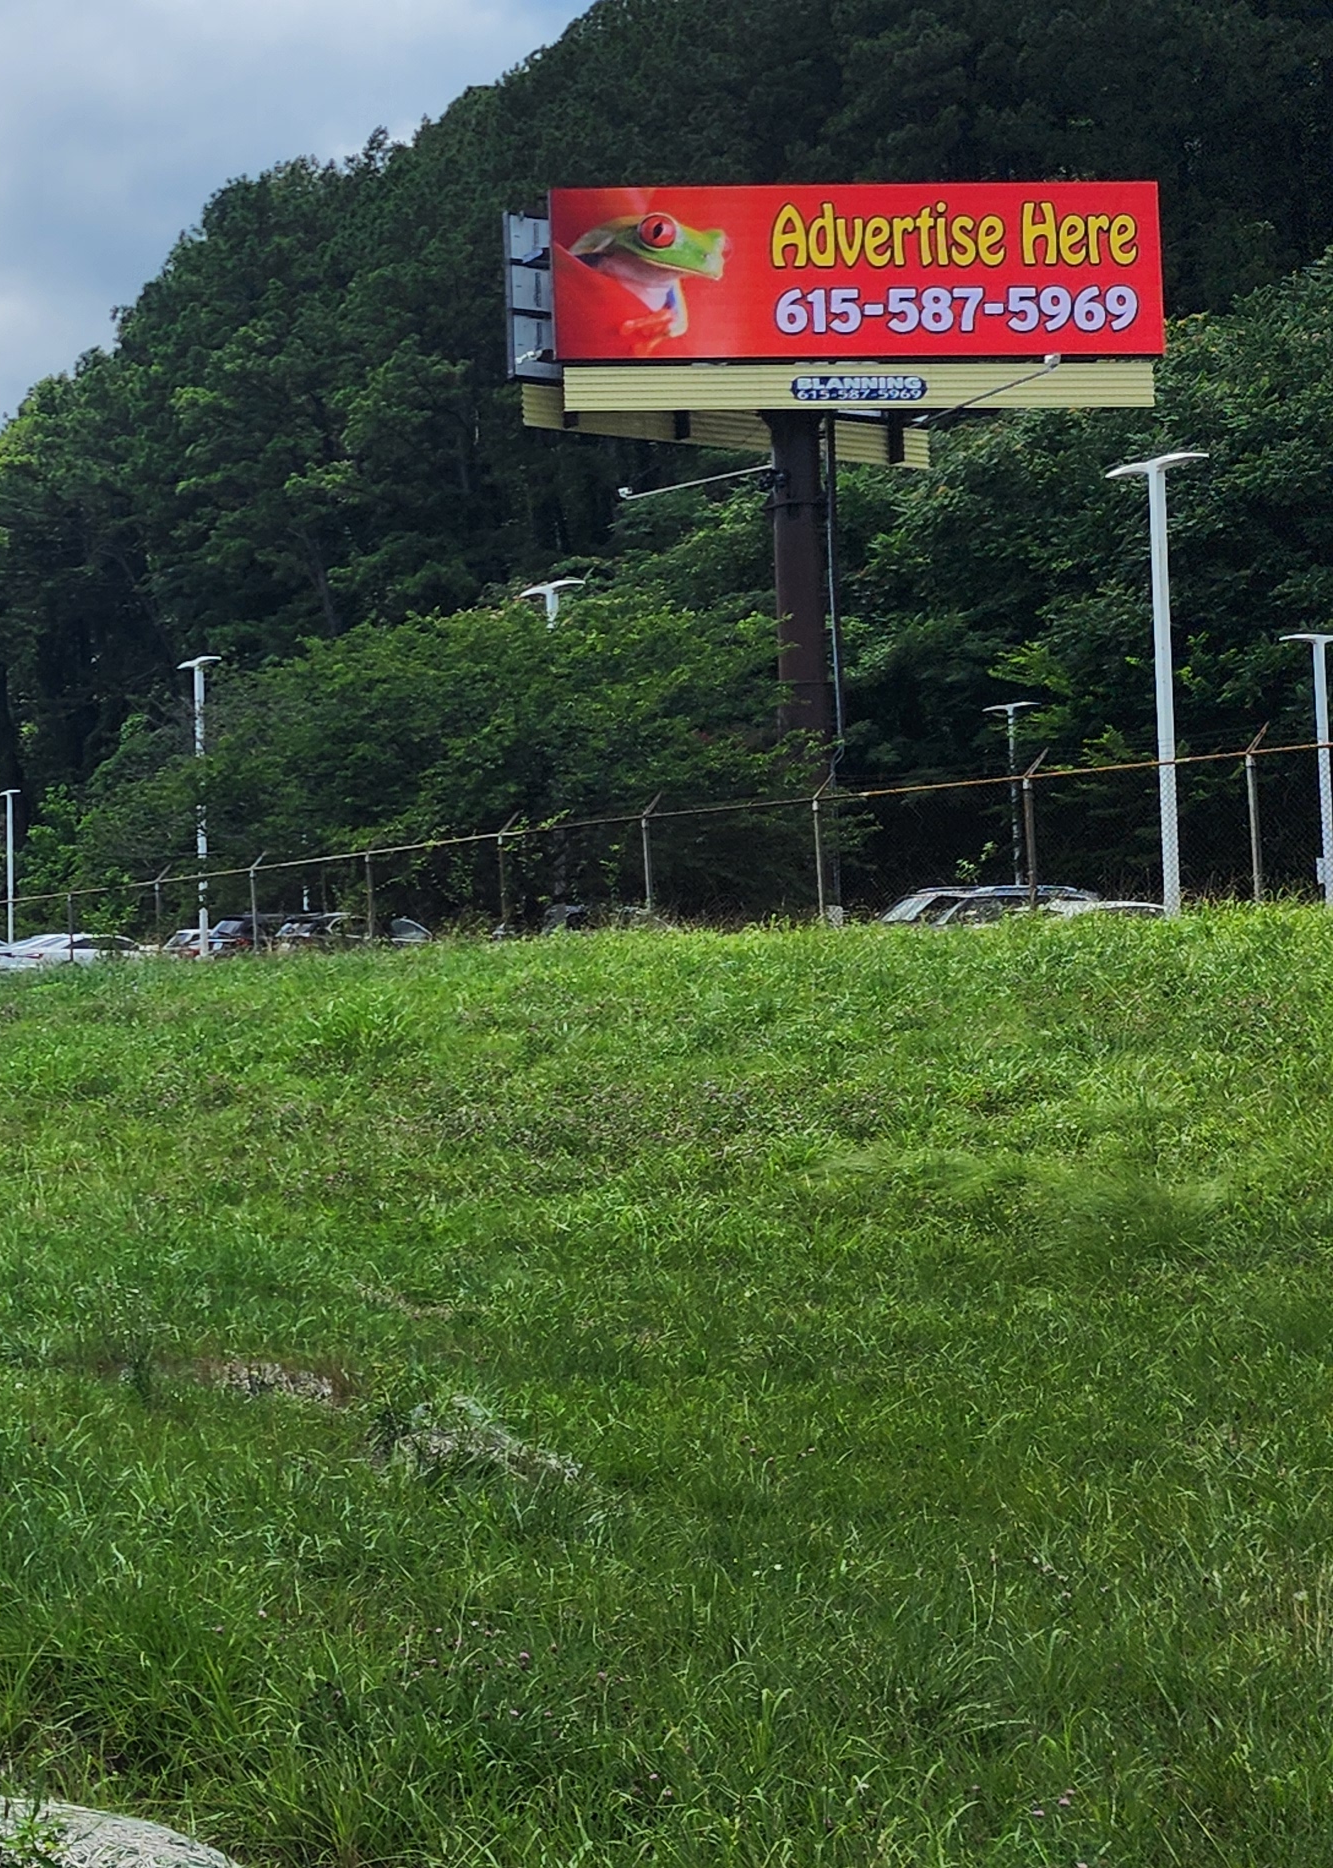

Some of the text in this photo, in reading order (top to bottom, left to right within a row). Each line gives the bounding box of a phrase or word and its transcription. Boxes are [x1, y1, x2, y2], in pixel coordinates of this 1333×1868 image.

[770, 200, 1138, 268] Advertise Here
[774, 284, 1139, 335] 615-587-5969
[796, 376, 922, 390] BLANNING
[796, 389, 922, 400] 615-587-5969
